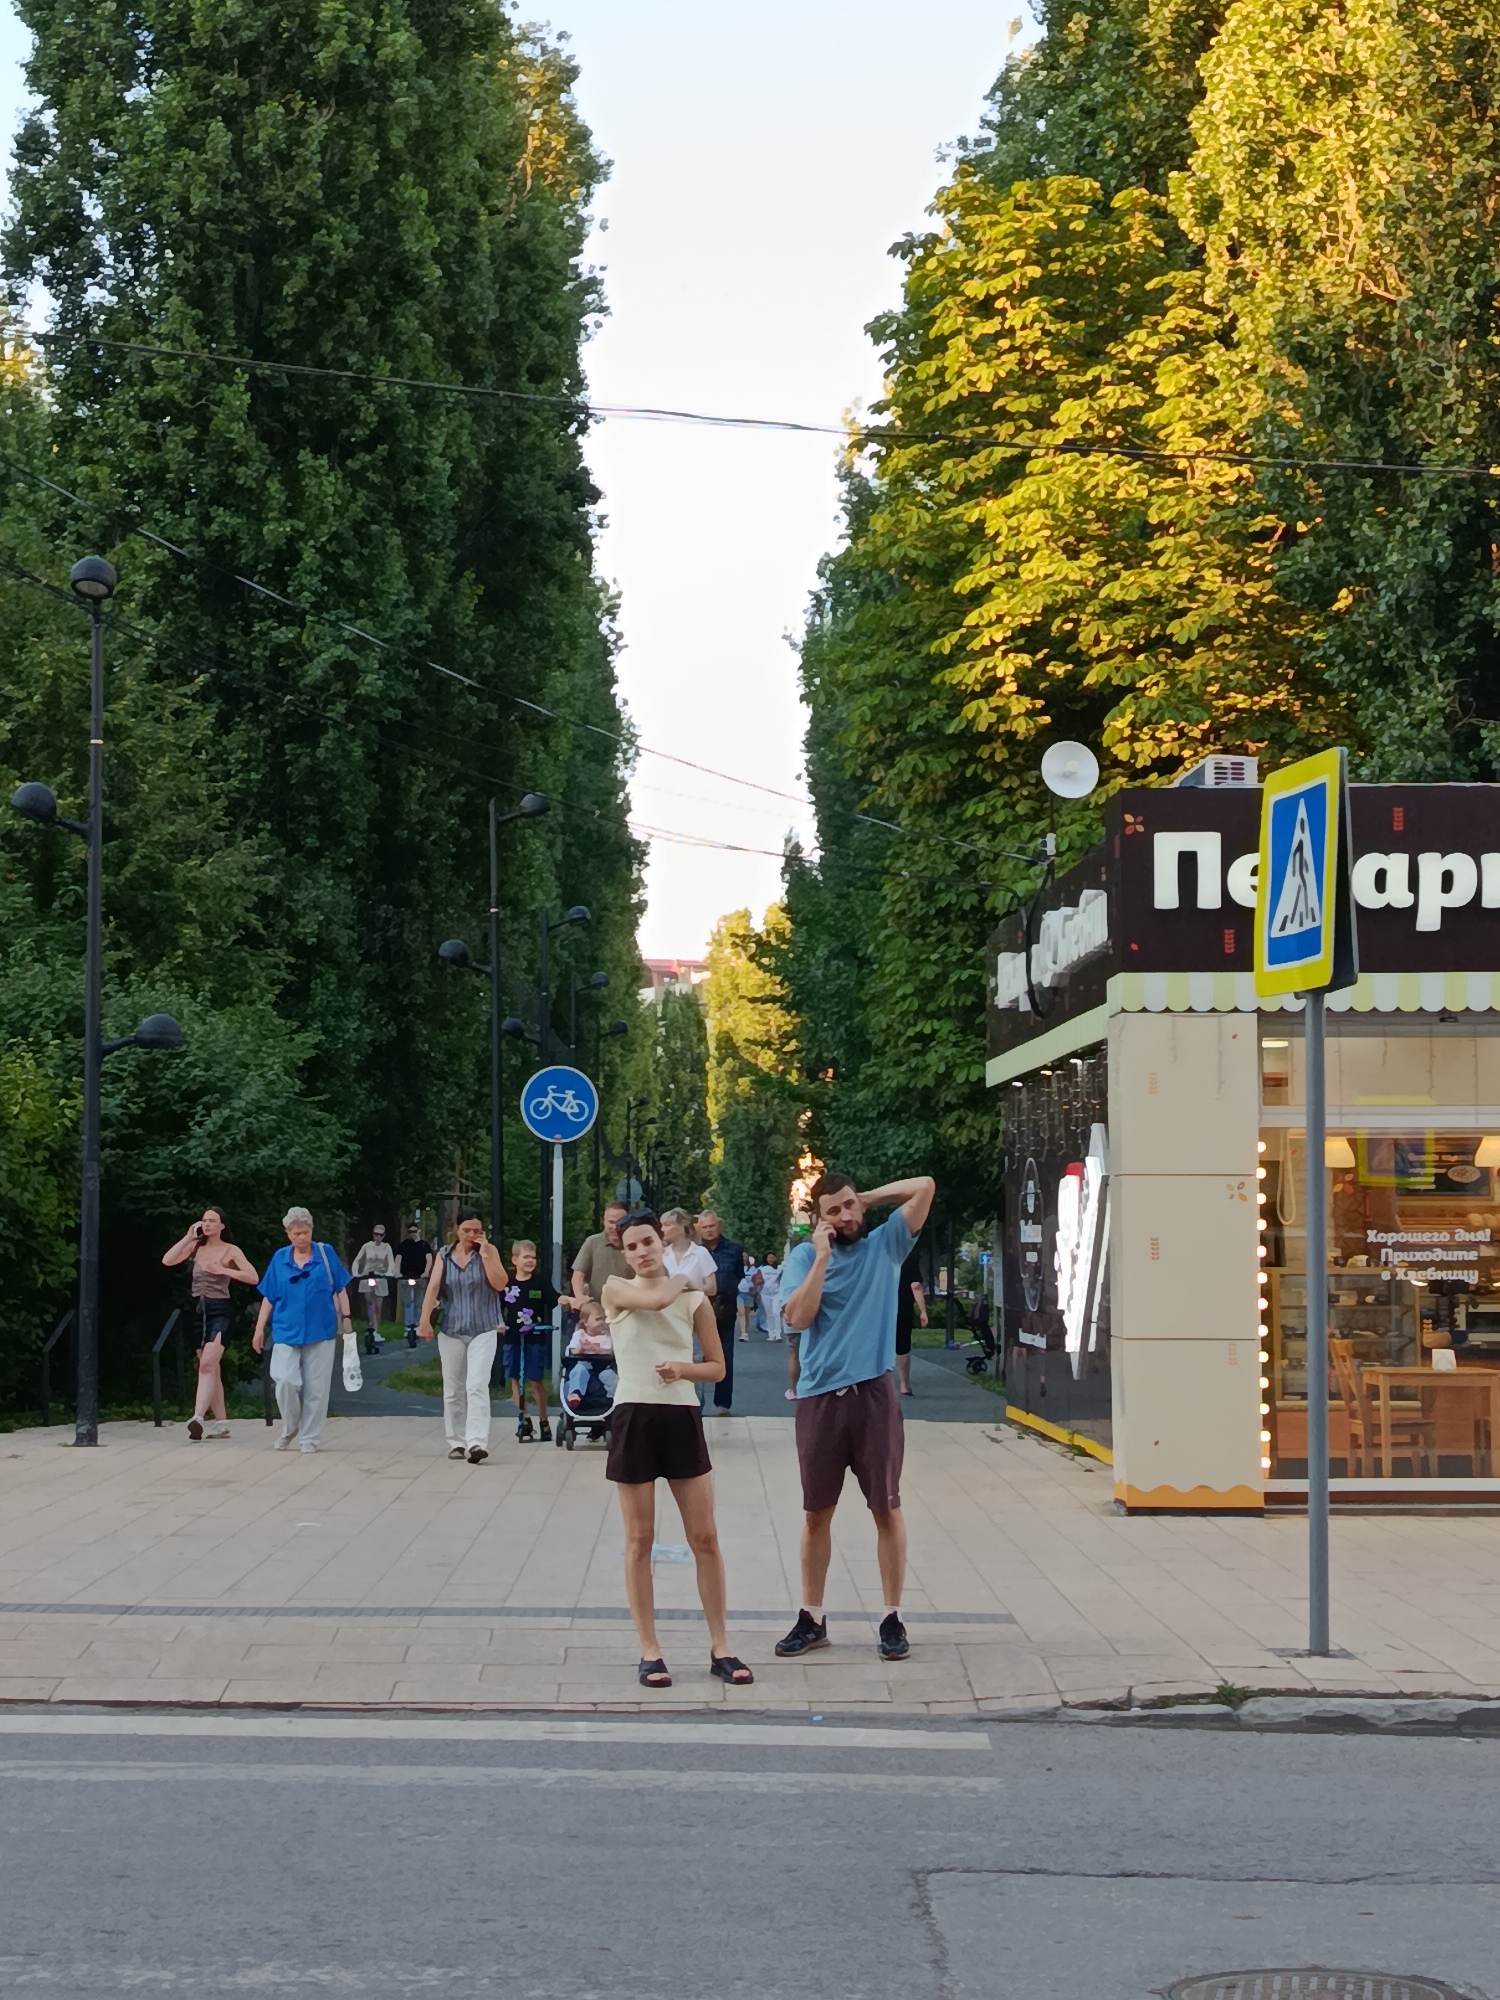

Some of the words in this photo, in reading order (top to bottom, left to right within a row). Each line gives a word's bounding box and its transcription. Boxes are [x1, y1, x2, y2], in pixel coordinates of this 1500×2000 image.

[1153, 831, 1500, 932] Пеар
[1366, 1229, 1450, 1246] Хорошего
[1454, 1228, 1491, 1242] дня!
[1381, 1247, 1478, 1266] Приходите
